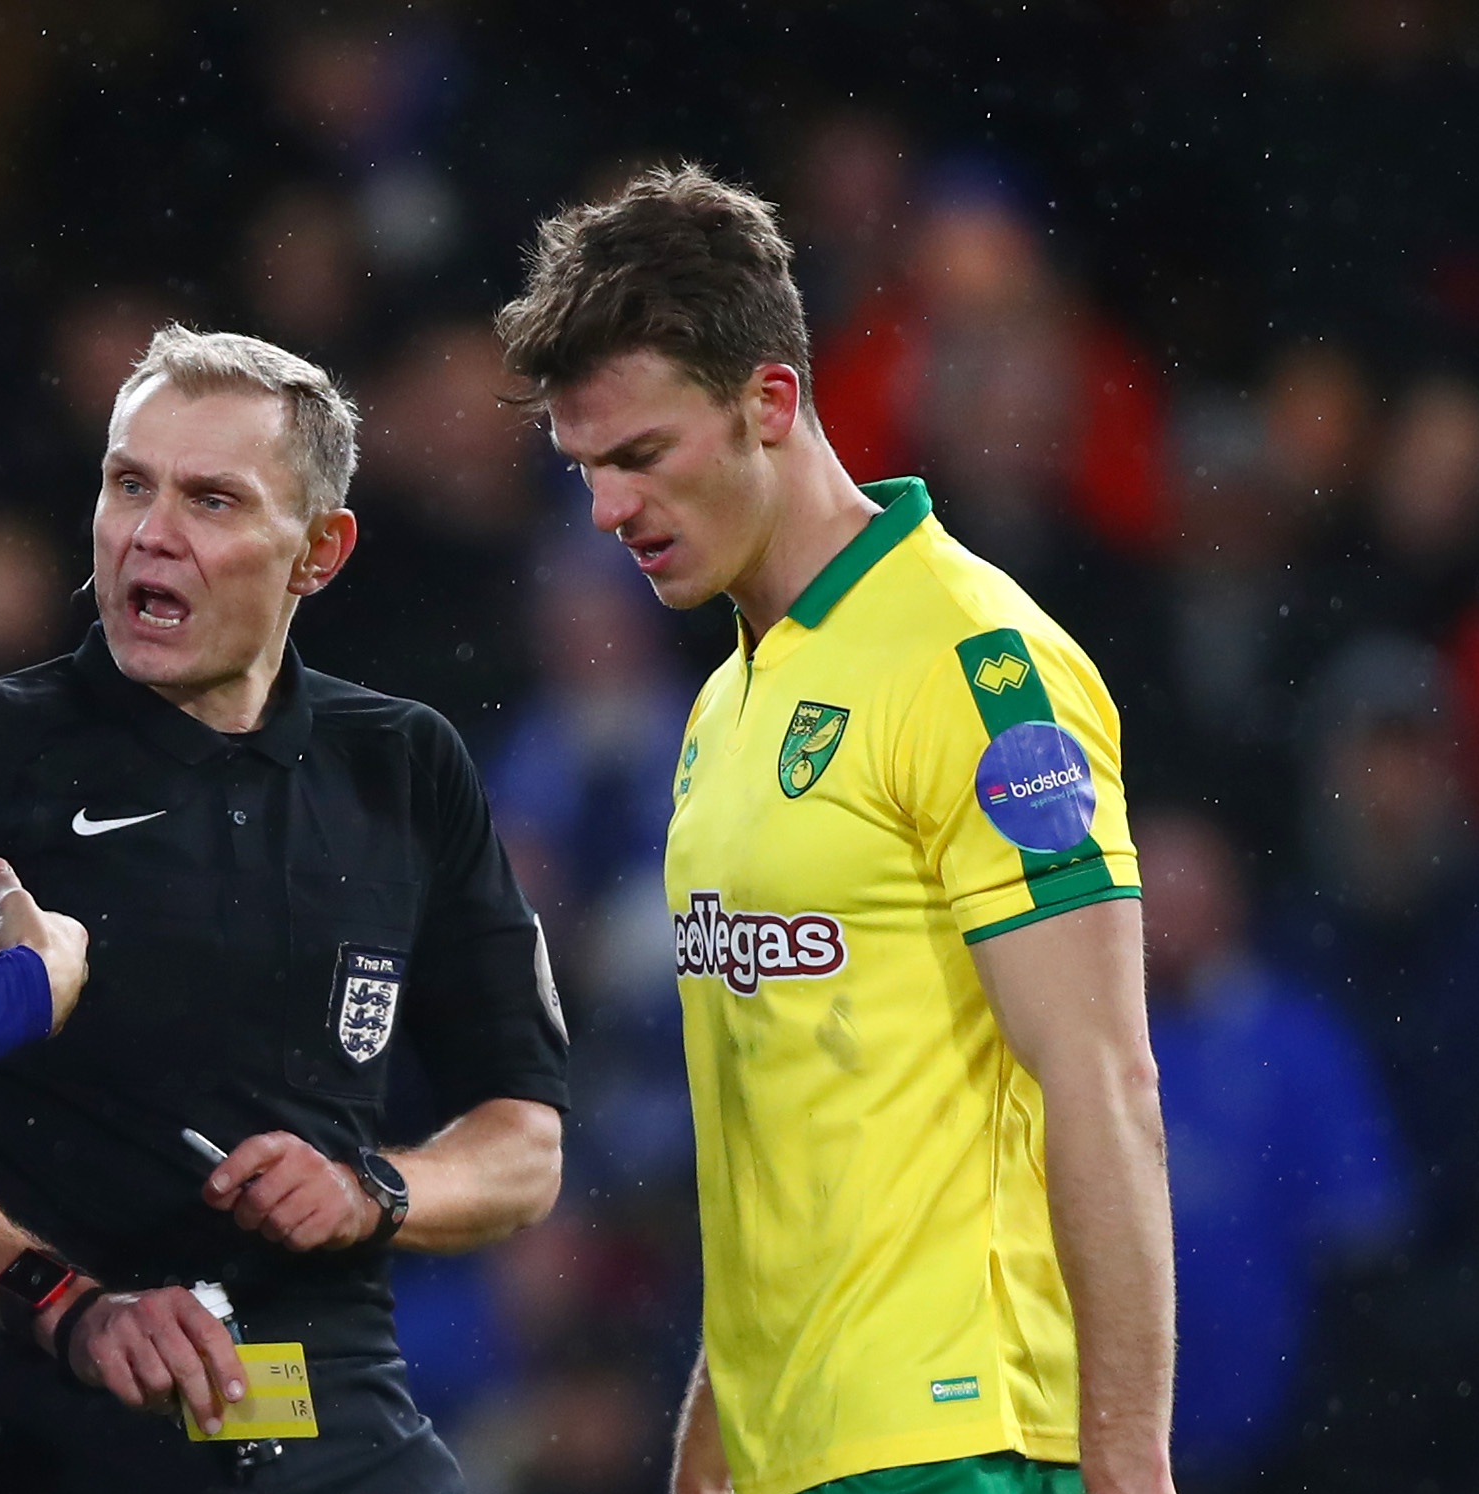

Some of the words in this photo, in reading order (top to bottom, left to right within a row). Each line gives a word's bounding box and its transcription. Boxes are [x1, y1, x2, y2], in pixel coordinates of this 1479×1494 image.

[1010, 763, 1083, 798] bidstack
[355, 955, 379, 971] The
[380, 959, 395, 973] FA
